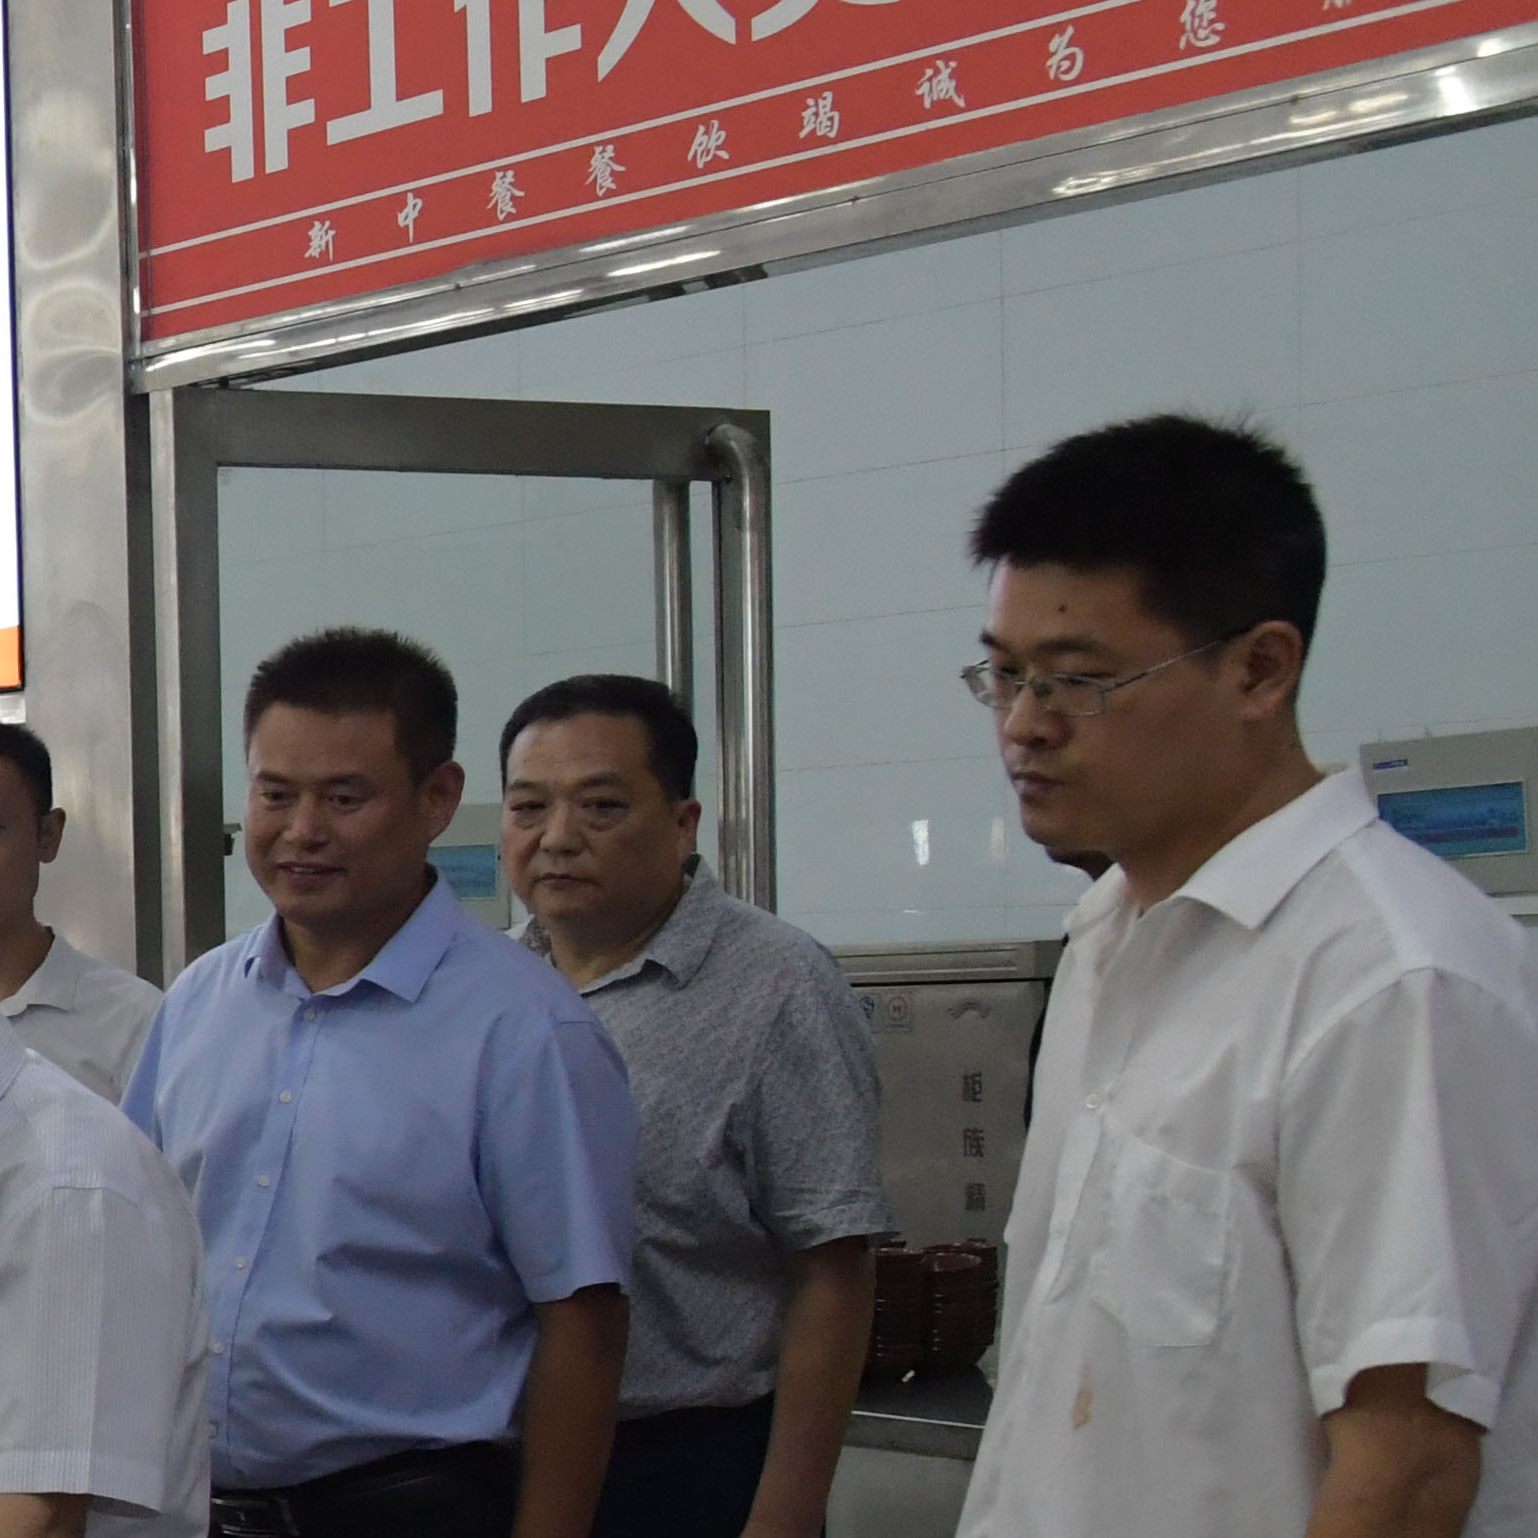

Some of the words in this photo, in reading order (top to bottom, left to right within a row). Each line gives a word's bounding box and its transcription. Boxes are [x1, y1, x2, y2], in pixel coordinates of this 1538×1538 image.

[305, 0, 1353, 262] 新中餐餐饮竭诚为您
